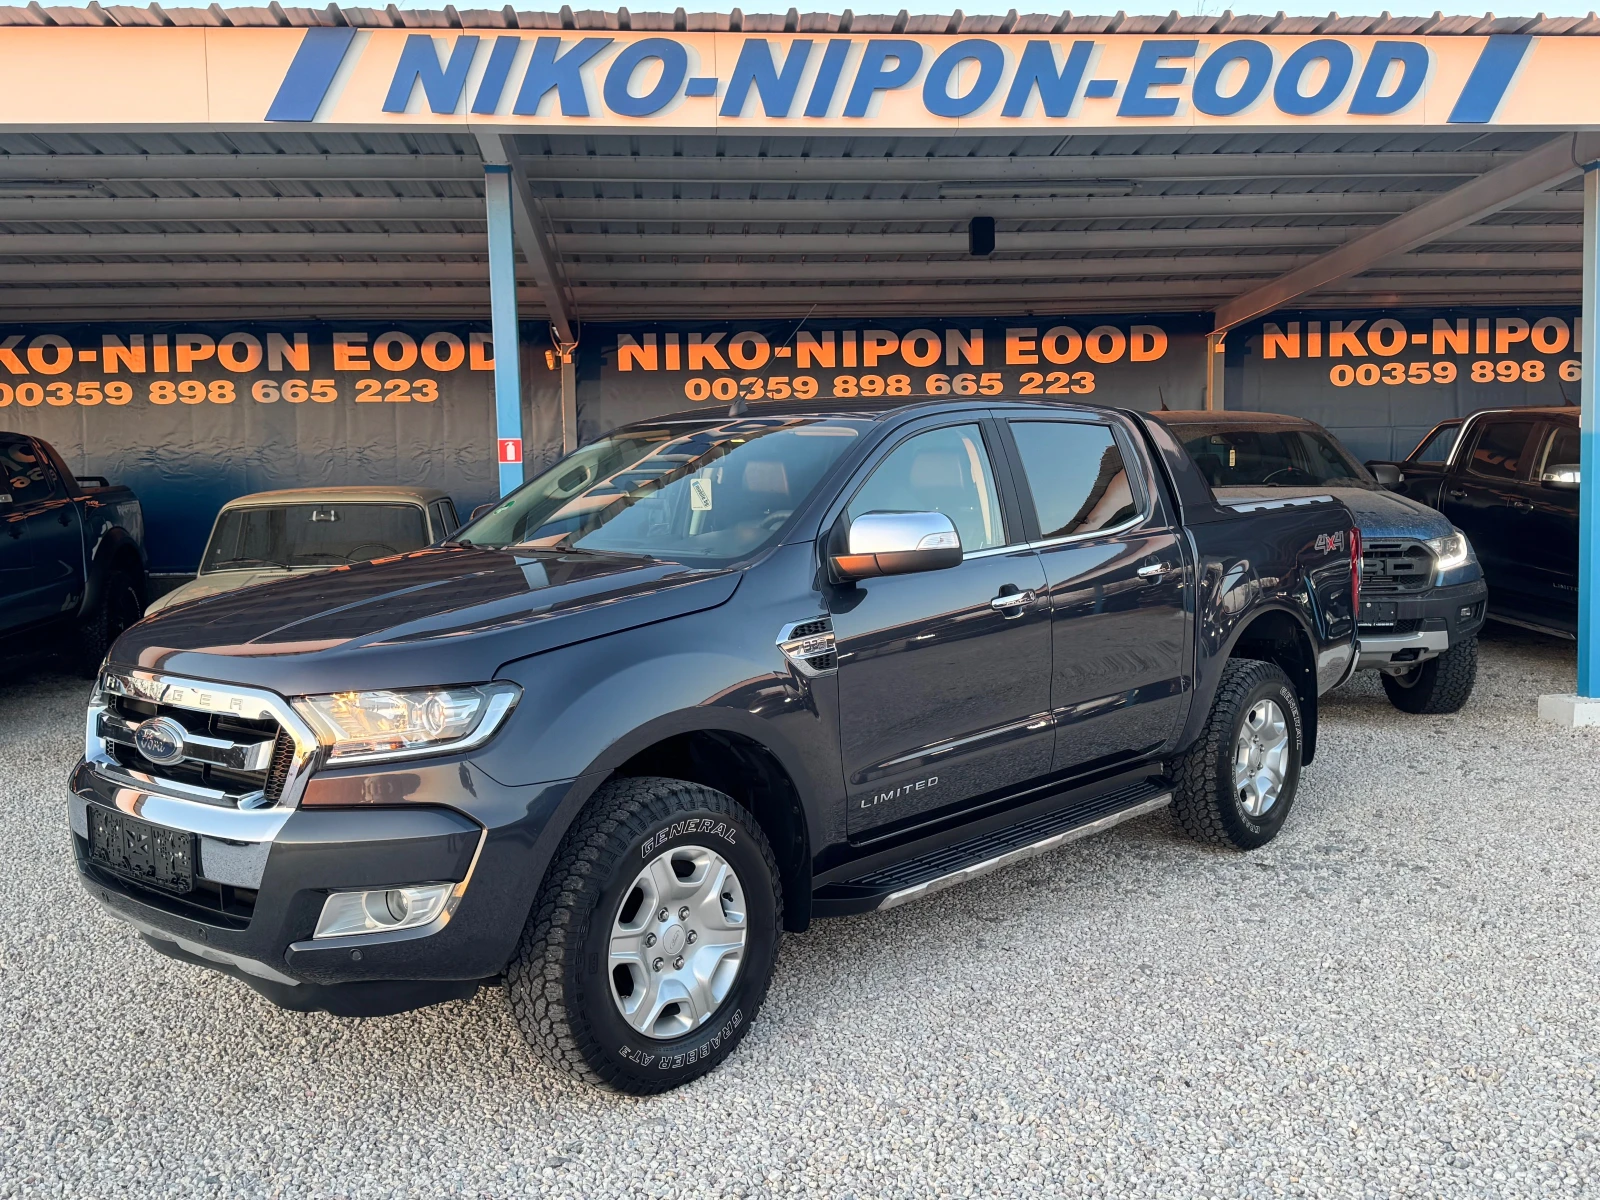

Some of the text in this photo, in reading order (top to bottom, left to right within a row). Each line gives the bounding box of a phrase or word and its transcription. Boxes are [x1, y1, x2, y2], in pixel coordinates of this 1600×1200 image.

[382, 34, 1429, 118] NIKO-NIPON-EOOD
[333, 331, 495, 372] EOOD
[617, 325, 1168, 371] NIKO-NIPON EOOD
[1263, 316, 1582, 360] NIKO-NIPO
[149, 380, 236, 405] 898
[252, 379, 338, 404] 665
[355, 379, 439, 403] 223
[684, 371, 1096, 401] 00359 898 665 223
[1330, 361, 1457, 387] 00359
[1471, 360, 1545, 383] 898
[1279, 686, 1303, 751] GENERAL
[140, 731, 167, 753] Ford
[860, 776, 939, 808] LIMITED
[641, 819, 736, 859] GENERAL
[618, 1009, 743, 1070] GRABBER AT3
